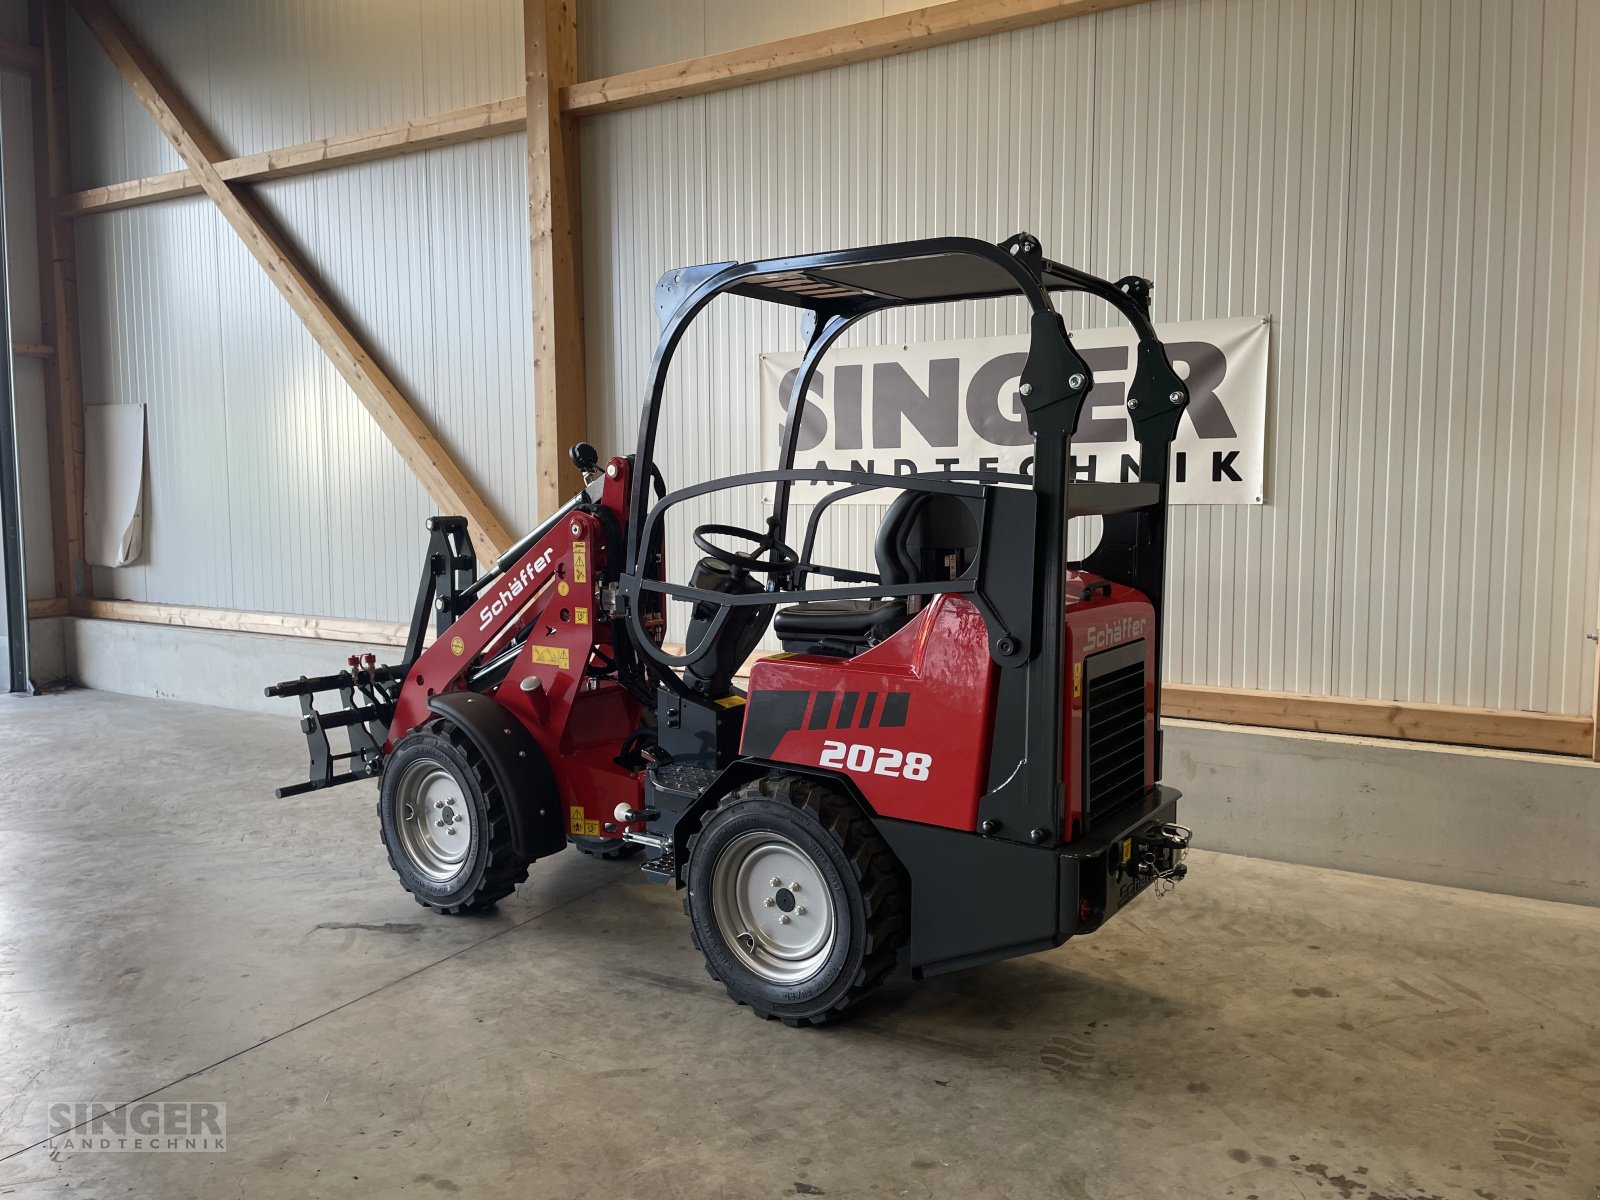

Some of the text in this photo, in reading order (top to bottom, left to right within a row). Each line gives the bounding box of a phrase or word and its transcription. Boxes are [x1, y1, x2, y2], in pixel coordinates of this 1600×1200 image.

[778, 341, 1238, 451] SINGER
[789, 451, 1242, 486] ANDTEHNIK
[479, 547, 553, 631] Schäffer
[1083, 617, 1147, 652] Schäffer
[819, 740, 932, 781] 2028
